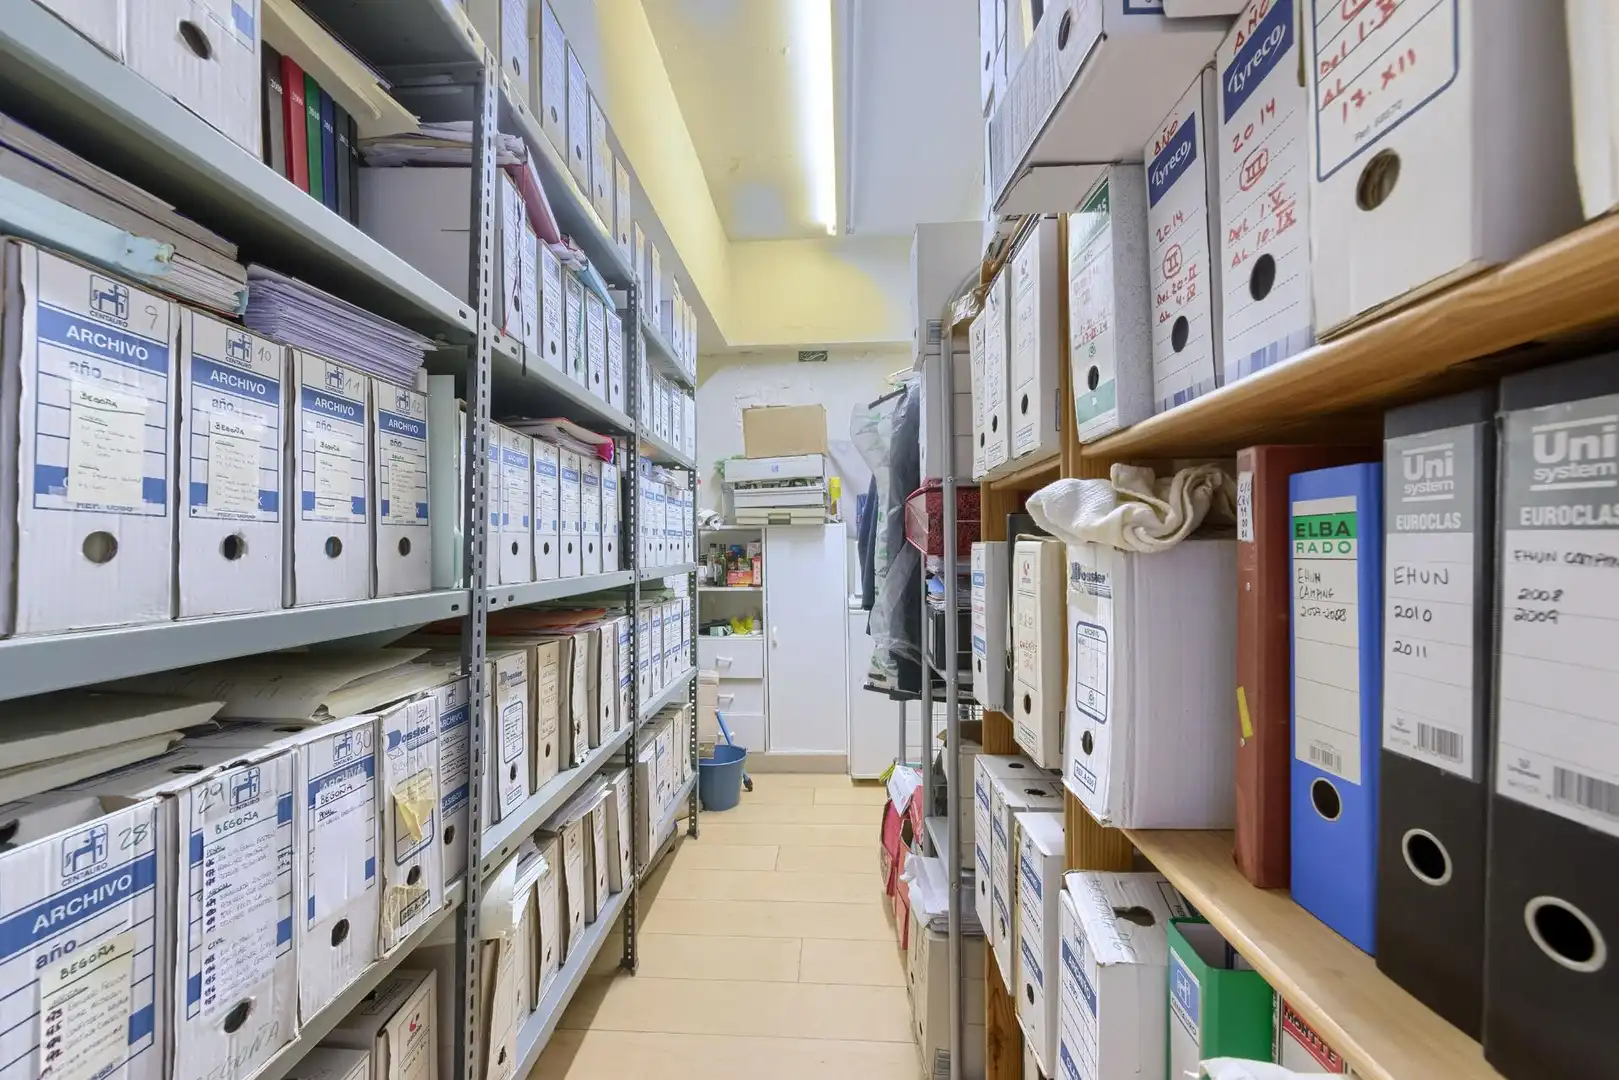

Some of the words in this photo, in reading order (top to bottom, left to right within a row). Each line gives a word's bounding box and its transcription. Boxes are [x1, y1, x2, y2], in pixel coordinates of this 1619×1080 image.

[1228, 24, 1286, 93] Lyreco
[1152, 141, 1191, 186] Lyreco
[89, 309, 129, 328] CENTAURO
[145, 305, 158, 331] 9
[66, 325, 149, 361] ARCHIVO
[257, 346, 272, 362] 10
[69, 361, 102, 380] año
[210, 369, 266, 395] ARCHIVO
[344, 378, 361, 394] 11
[211, 398, 235, 413] año
[314, 396, 355, 417] ARCHIVO
[316, 420, 332, 432] año
[388, 418, 419, 434] ARCHIVO
[1533, 423, 1618, 465] Uni
[1403, 451, 1454, 482] Uni
[1533, 462, 1618, 484] system
[1404, 478, 1455, 497] system
[1295, 520, 1352, 538] ELBA
[1396, 511, 1462, 531] EUROCLAS
[1295, 540, 1352, 554] RADO
[1394, 566, 1449, 586] EHUN
[1394, 605, 1433, 622] 2010
[1392, 640, 1427, 659] 2011
[353, 729, 372, 757] 30
[198, 782, 224, 815] 29
[320, 783, 353, 805] BEGOÑA
[215, 810, 259, 835] BEGOÑA
[118, 822, 150, 851] 28
[61, 862, 108, 887] CENTAURO
[32, 874, 133, 935] ARCHIVO
[35, 940, 77, 970] año
[60, 943, 116, 980] BEGOÑA
